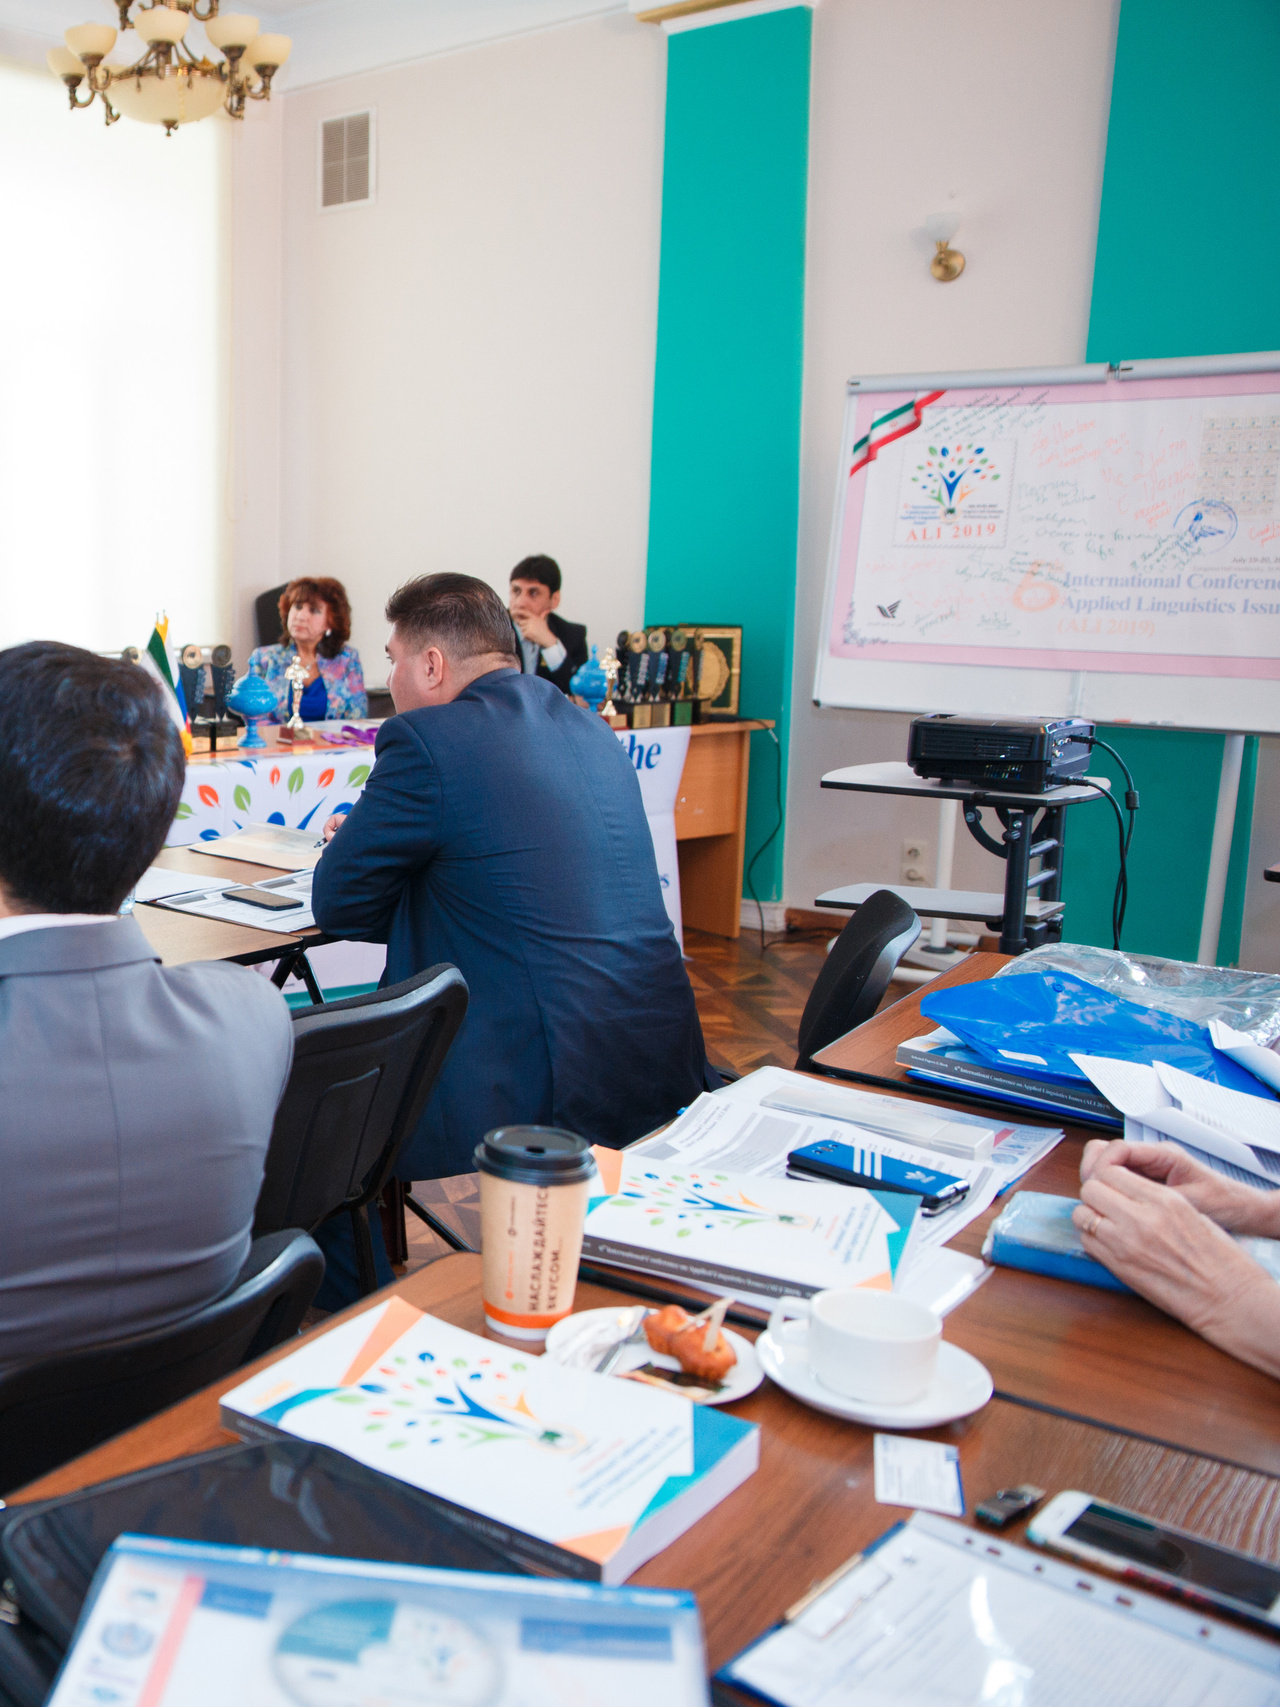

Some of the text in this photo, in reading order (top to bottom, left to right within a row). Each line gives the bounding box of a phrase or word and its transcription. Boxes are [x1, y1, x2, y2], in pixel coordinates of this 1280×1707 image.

[906, 522, 996, 542] ALI 2019
[1064, 571, 1182, 590] International
[1061, 596, 1131, 614] Applied
[1136, 597, 1237, 616] Linguistics
[1057, 617, 1156, 638] (ALI 2019)
[961, 1067, 990, 1079] International
[990, 1075, 1016, 1086] Conference
[1023, 1083, 1042, 1093] Applied
[1042, 1086, 1068, 1099] Linguistics
[529, 1186, 550, 1312] НАСЛАЖДАЙТЕС
